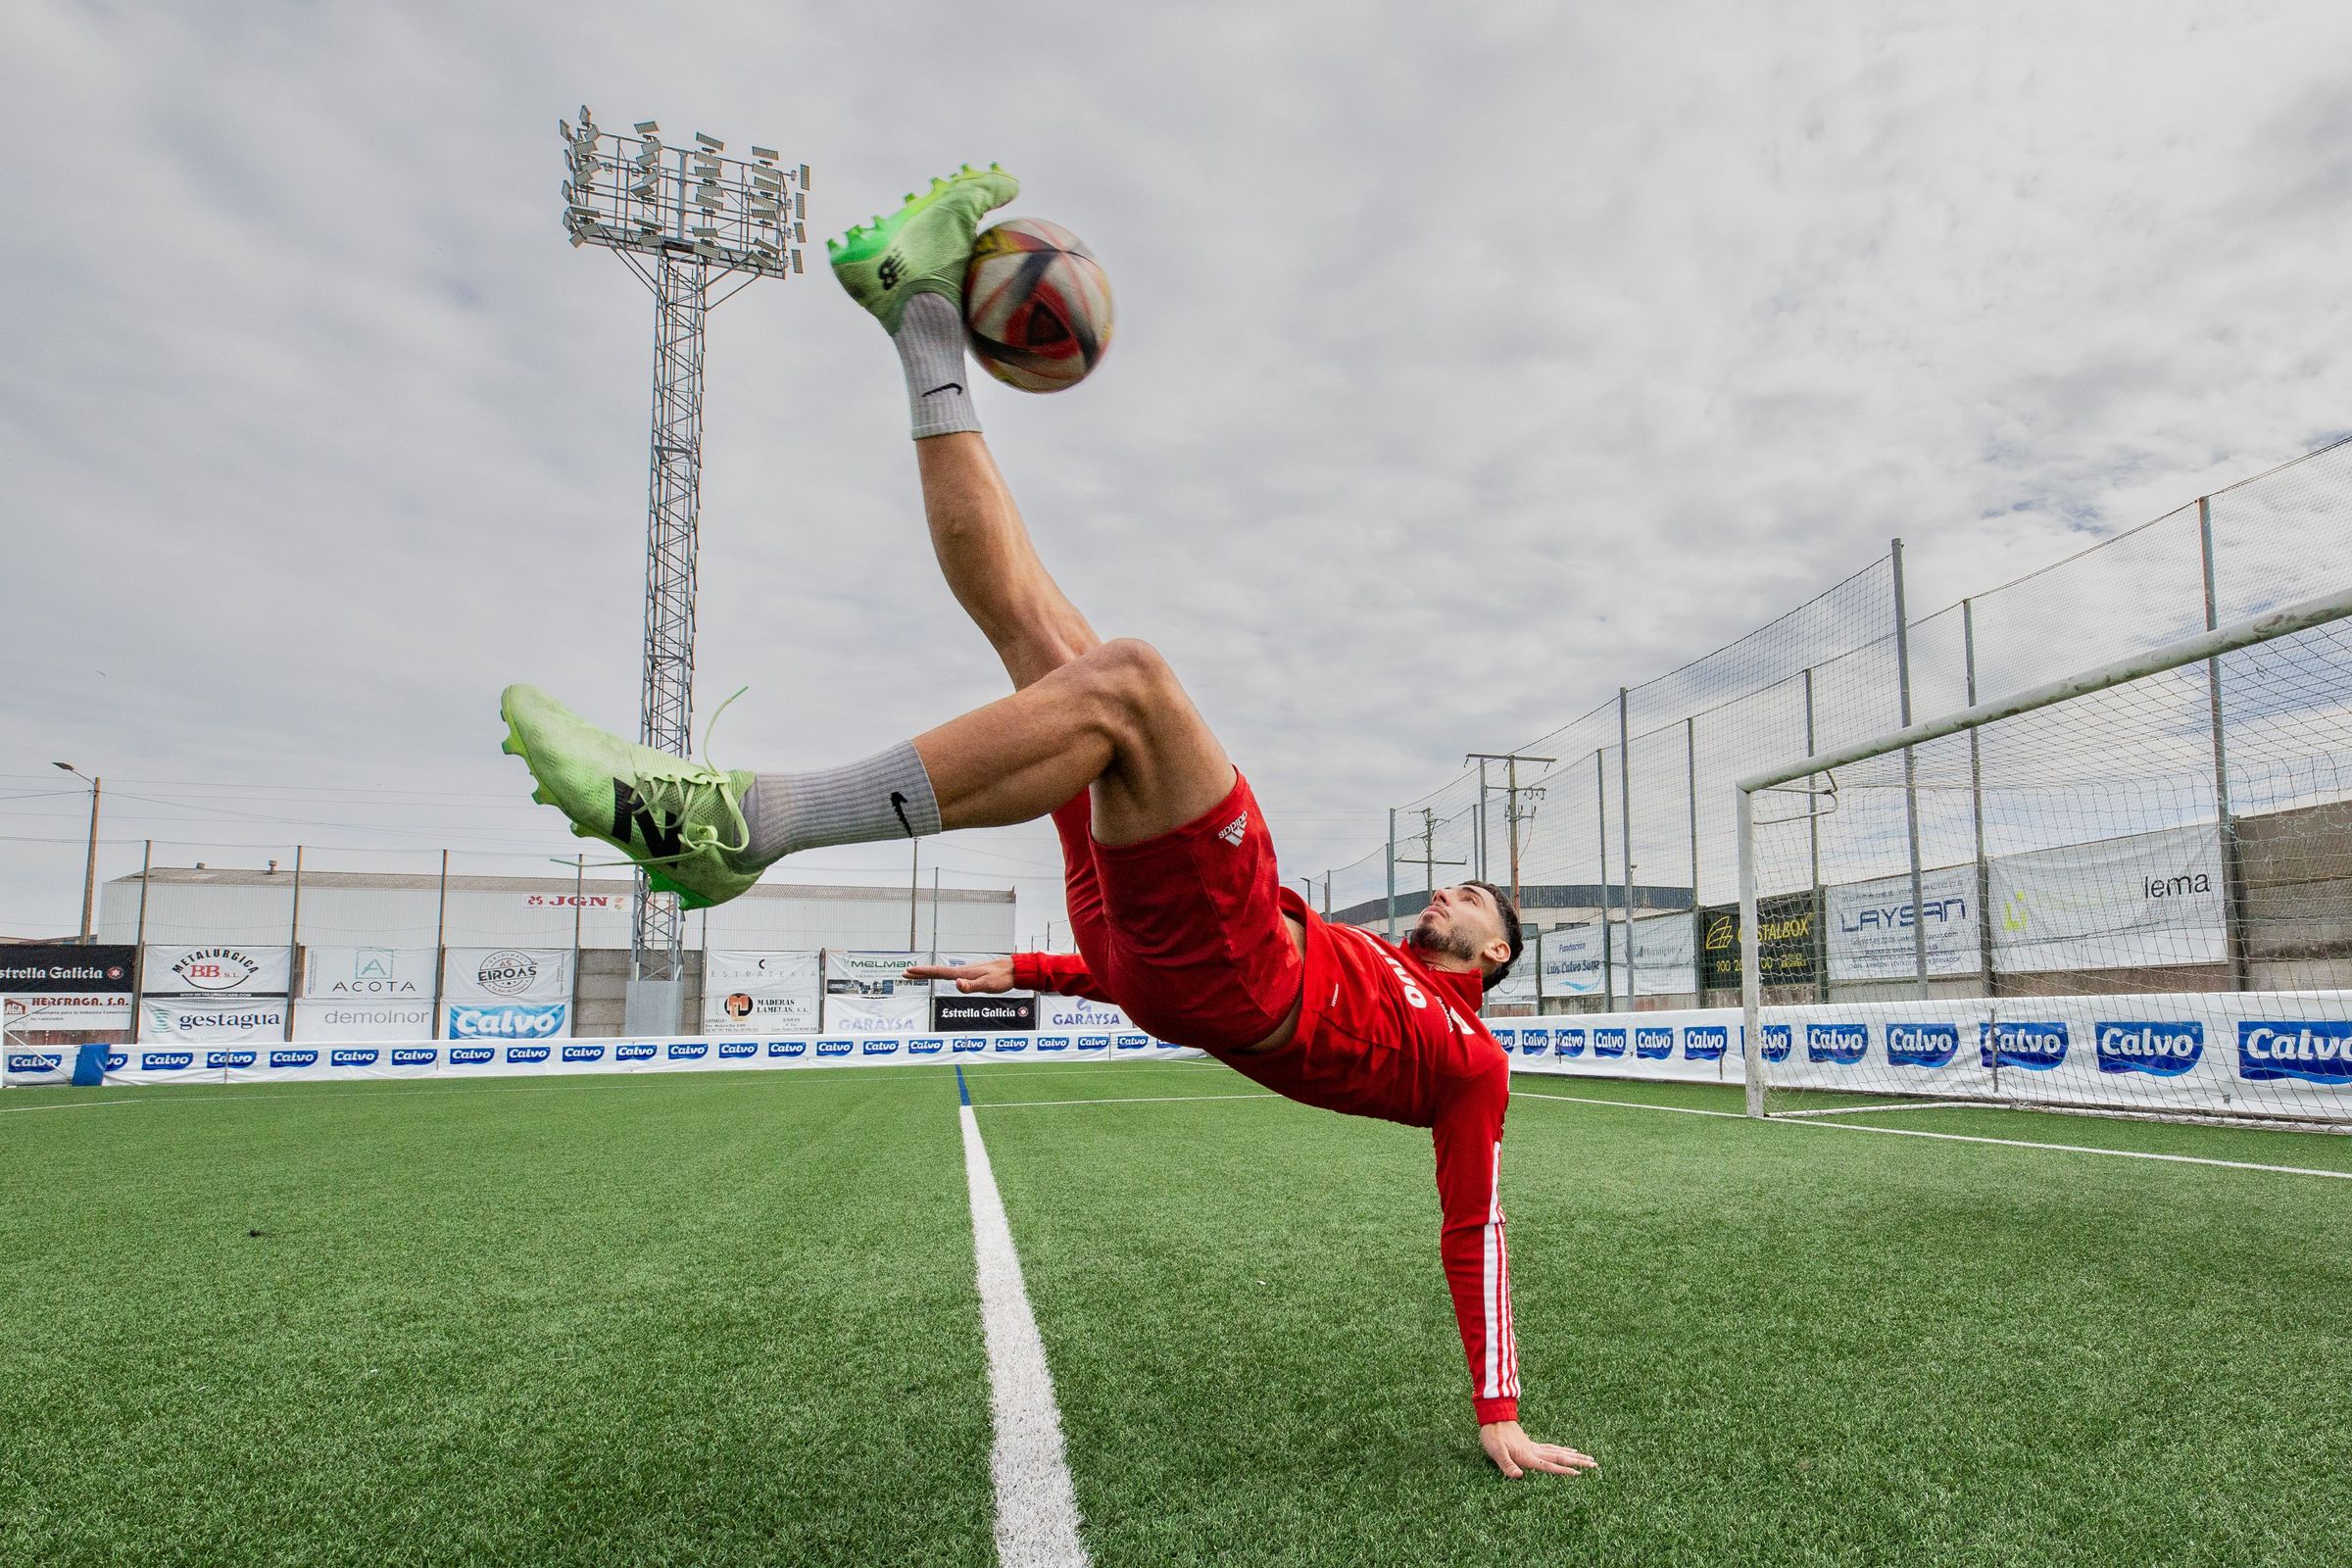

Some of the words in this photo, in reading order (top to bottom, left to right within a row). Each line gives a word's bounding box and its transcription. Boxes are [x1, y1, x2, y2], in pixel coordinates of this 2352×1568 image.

[1218, 810, 1248, 840] adidas
[2144, 873, 2211, 900] lema
[549, 896, 609, 906] JGN
[172, 949, 259, 974] METALURGICA
[1561, 960, 1581, 974] Calvo
[0, 966, 47, 979] strella
[49, 966, 103, 979] Galicia
[478, 966, 537, 981] EIROAS
[332, 981, 416, 992] ACOTA
[107, 997, 129, 1005] S.A.
[324, 1009, 430, 1024] demolnor
[941, 1006, 980, 1018] Estrella
[981, 1006, 1016, 1018] Galicia
[179, 1012, 280, 1030] gestagua
[456, 1009, 556, 1036] Calvo
[838, 1018, 915, 1031] GARAYSA
[1053, 1013, 1121, 1025] GARAYSA
[909, 1040, 940, 1050] Calvo
[997, 1039, 1027, 1048] Calvo
[1039, 1038, 1068, 1048] Calvo
[1079, 1037, 1107, 1047] Calvo
[1119, 1036, 1147, 1046] Calvo
[1523, 1032, 1547, 1047] Calvo
[1557, 1031, 1584, 1048] Calvo
[1595, 1031, 1624, 1049] Calvo
[1638, 1031, 1671, 1049] Calvo
[1687, 1030, 1725, 1050] Calvo
[1761, 1030, 1788, 1050] lvo
[1810, 1029, 1864, 1051] Calvo
[1889, 1029, 1952, 1052] Calvo
[1984, 1029, 2061, 1054] Calvo
[2101, 1028, 2194, 1056] Calvo
[564, 1047, 602, 1057] Calvo
[617, 1046, 654, 1056] Calvo
[670, 1045, 706, 1055] Calvo
[721, 1044, 755, 1054] Calvo
[770, 1043, 804, 1053] Calvo
[818, 1042, 851, 1052] Calvo
[864, 1041, 897, 1051] Calvo
[272, 1052, 315, 1062] Calvo
[333, 1051, 375, 1061] Calvo
[394, 1050, 434, 1060] Calvo
[452, 1049, 491, 1059] Calvo
[509, 1048, 548, 1058] Calvo
[145, 1054, 189, 1065] Calvo
